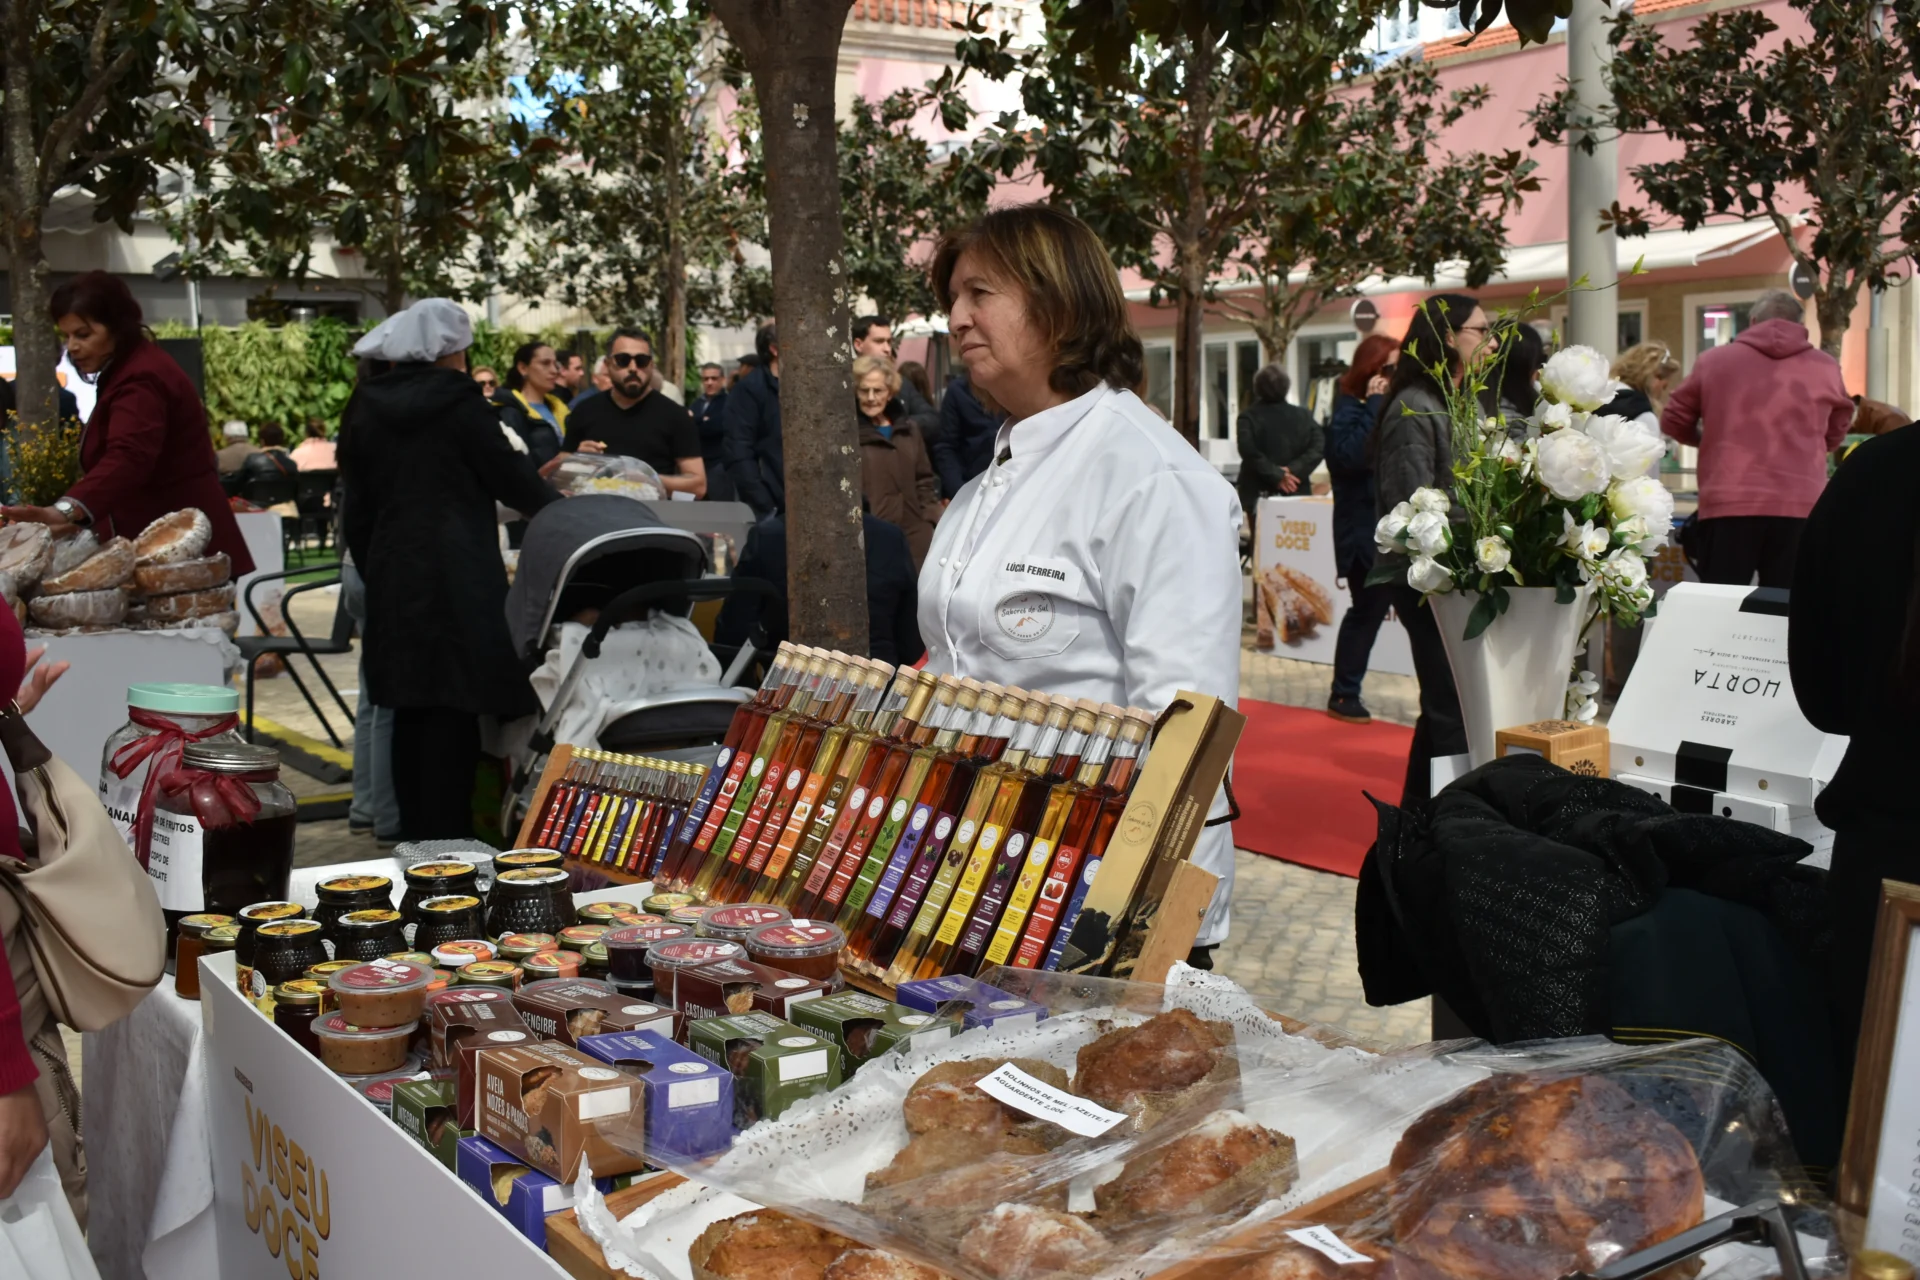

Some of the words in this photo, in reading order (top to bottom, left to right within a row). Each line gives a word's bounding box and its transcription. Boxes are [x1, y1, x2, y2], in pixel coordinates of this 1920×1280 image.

[1280, 520, 1316, 536] VISEU
[1275, 536, 1310, 551] DOCE
[1006, 562, 1025, 572] LÚCIA
[1027, 565, 1066, 581] FERREIRA
[1694, 669, 1781, 698] HORTA
[1701, 715, 1736, 725] SABORES
[166, 820, 194, 833] FRUTOS
[523, 1011, 556, 1035] GENGIBRE
[487, 1073, 504, 1096] AVEIA
[994, 1076, 1043, 1105] AGUARDENTE
[1003, 1071, 1041, 1094] BOLINHOS
[1053, 1099, 1068, 1107] MEL
[486, 1093, 506, 1118] NOZES
[245, 1094, 330, 1241] VISEU
[242, 1160, 319, 1280] DOCE
